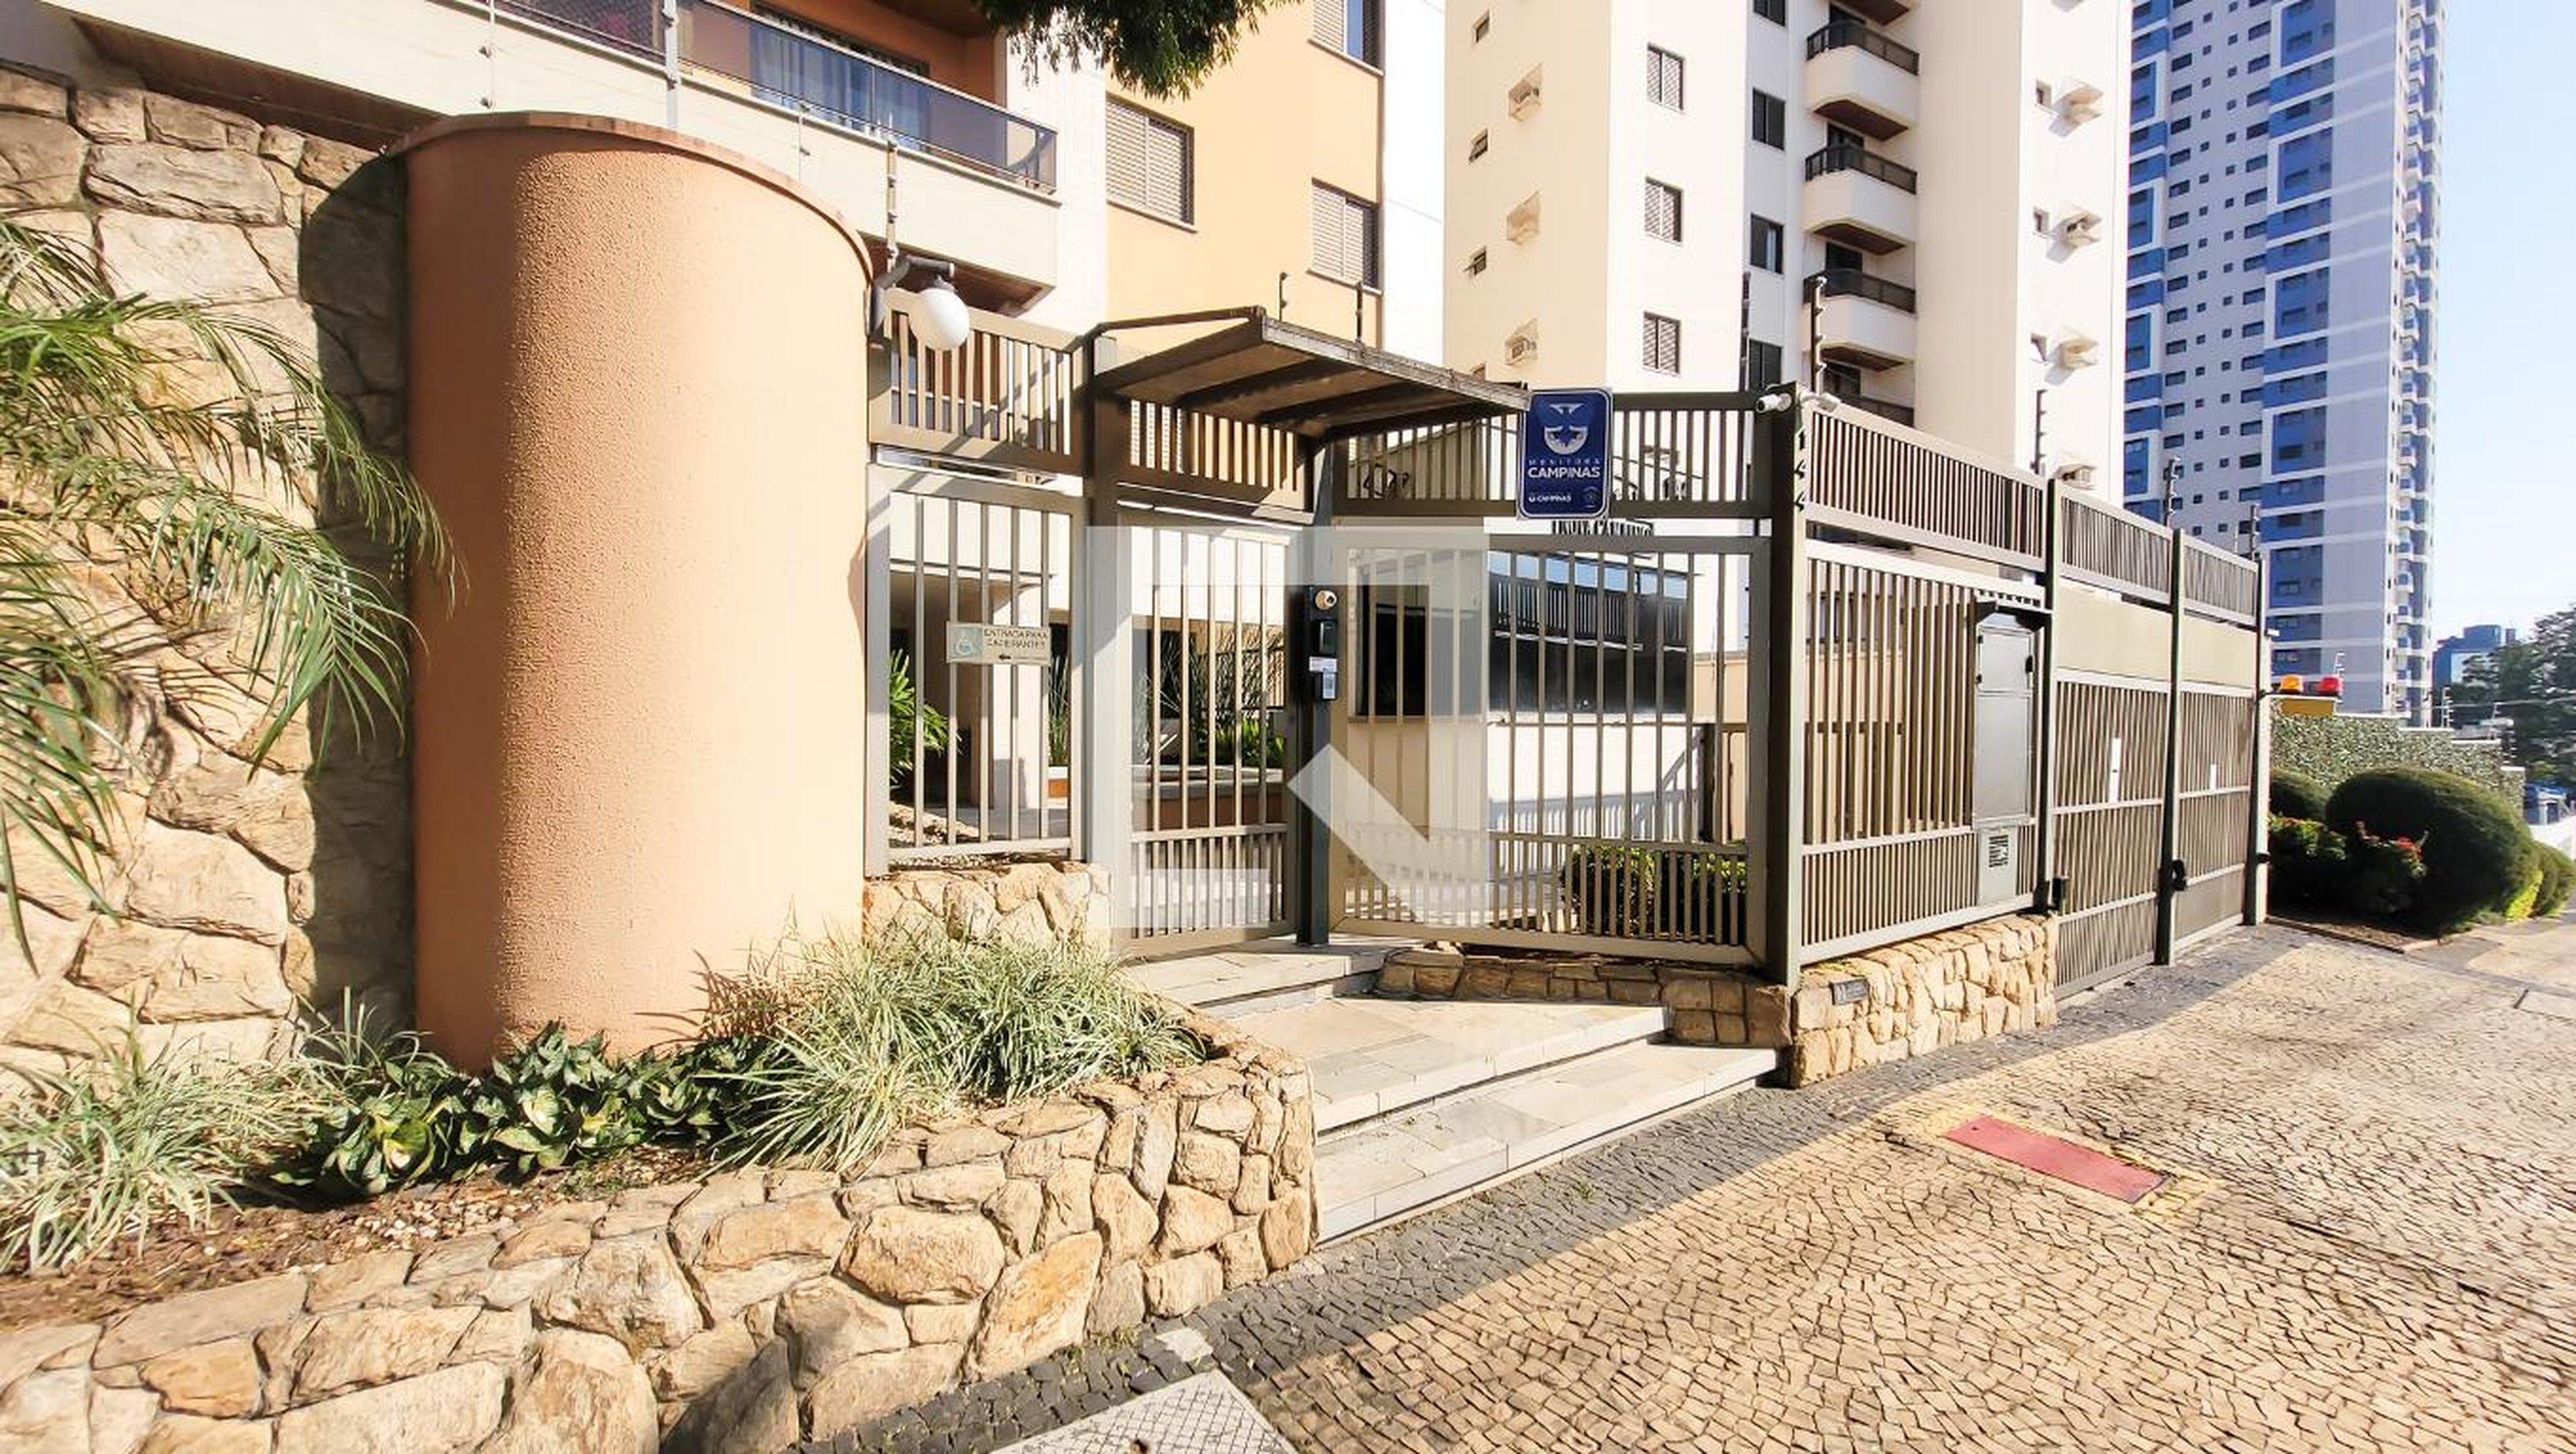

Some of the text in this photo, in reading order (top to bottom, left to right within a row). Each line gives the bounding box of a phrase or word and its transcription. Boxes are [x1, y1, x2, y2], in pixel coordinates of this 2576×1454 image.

[1527, 467, 1601, 478] CAMPINAS
[984, 629, 1048, 639] ENTRADA PARA
